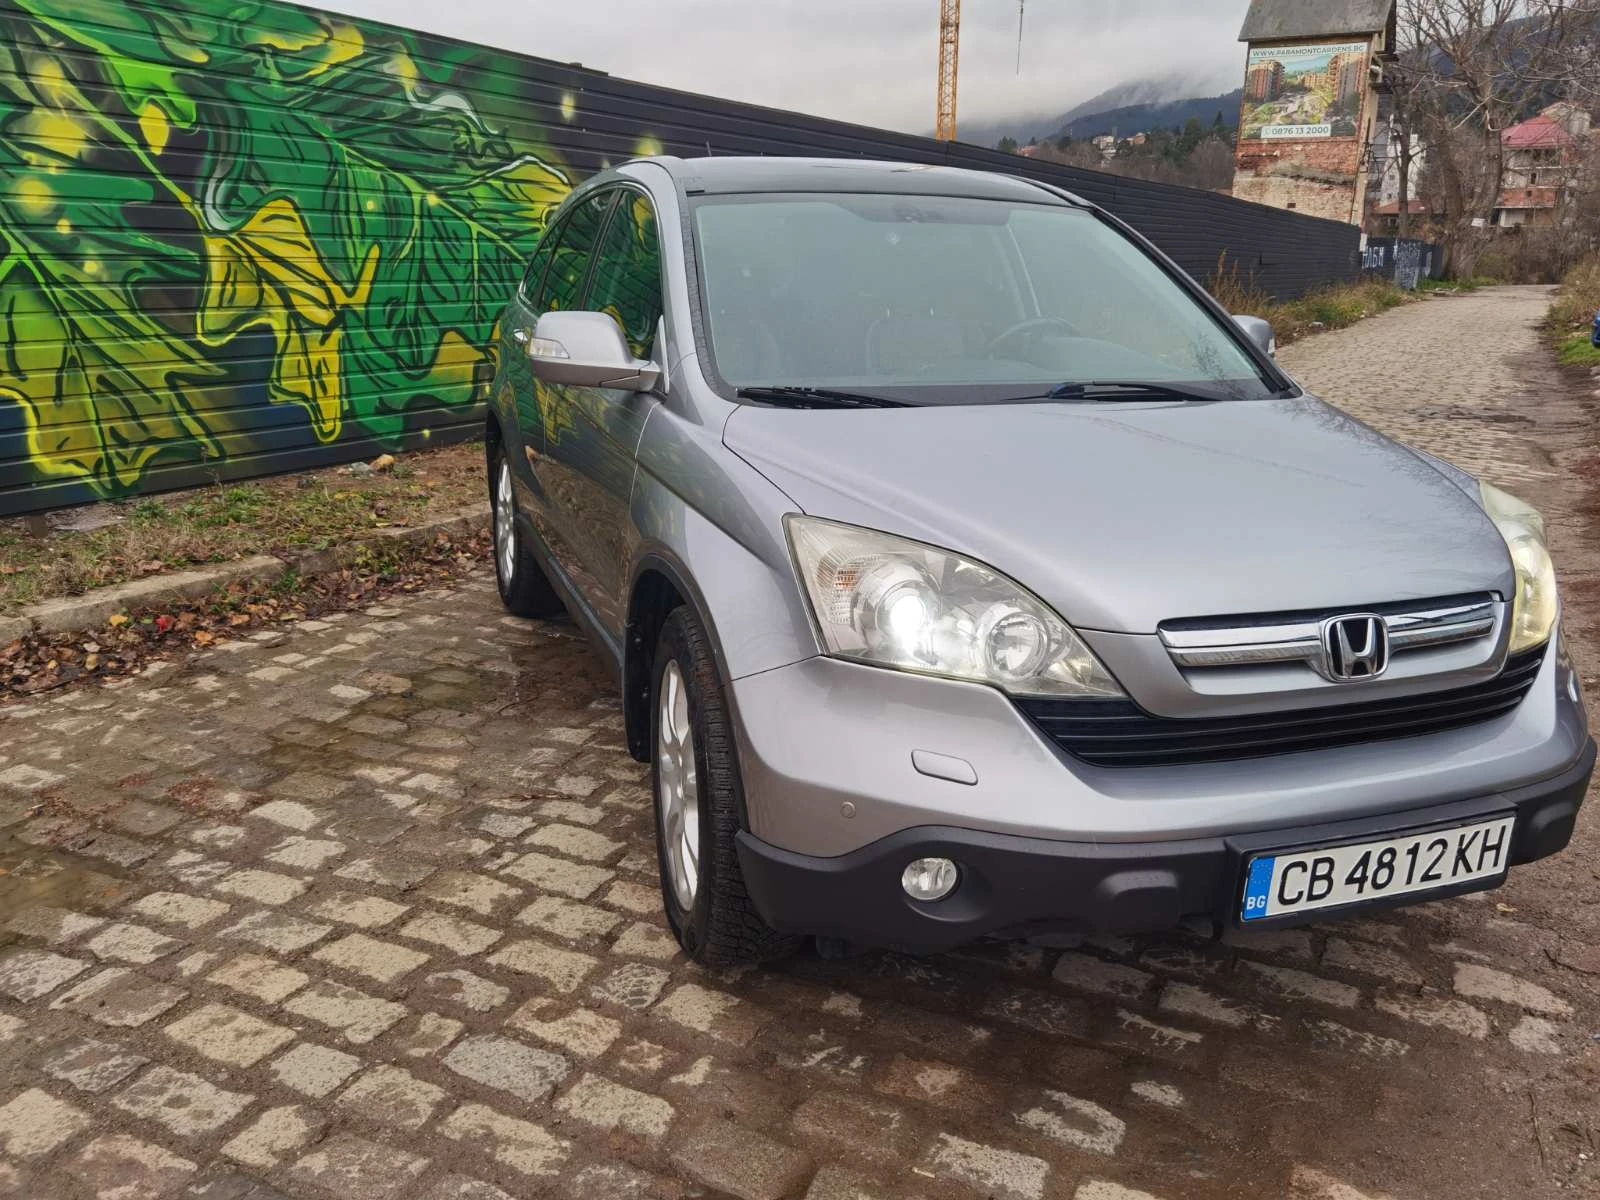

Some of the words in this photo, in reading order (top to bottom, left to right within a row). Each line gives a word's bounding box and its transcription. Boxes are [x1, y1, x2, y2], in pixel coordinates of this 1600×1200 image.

[1271, 127, 1294, 135] 0876
[1306, 126, 1329, 134] 2000
[1278, 857, 1335, 905] CB
[1344, 838, 1448, 894] 4812
[1451, 825, 1506, 876] KH
[1246, 895, 1266, 910] BG
